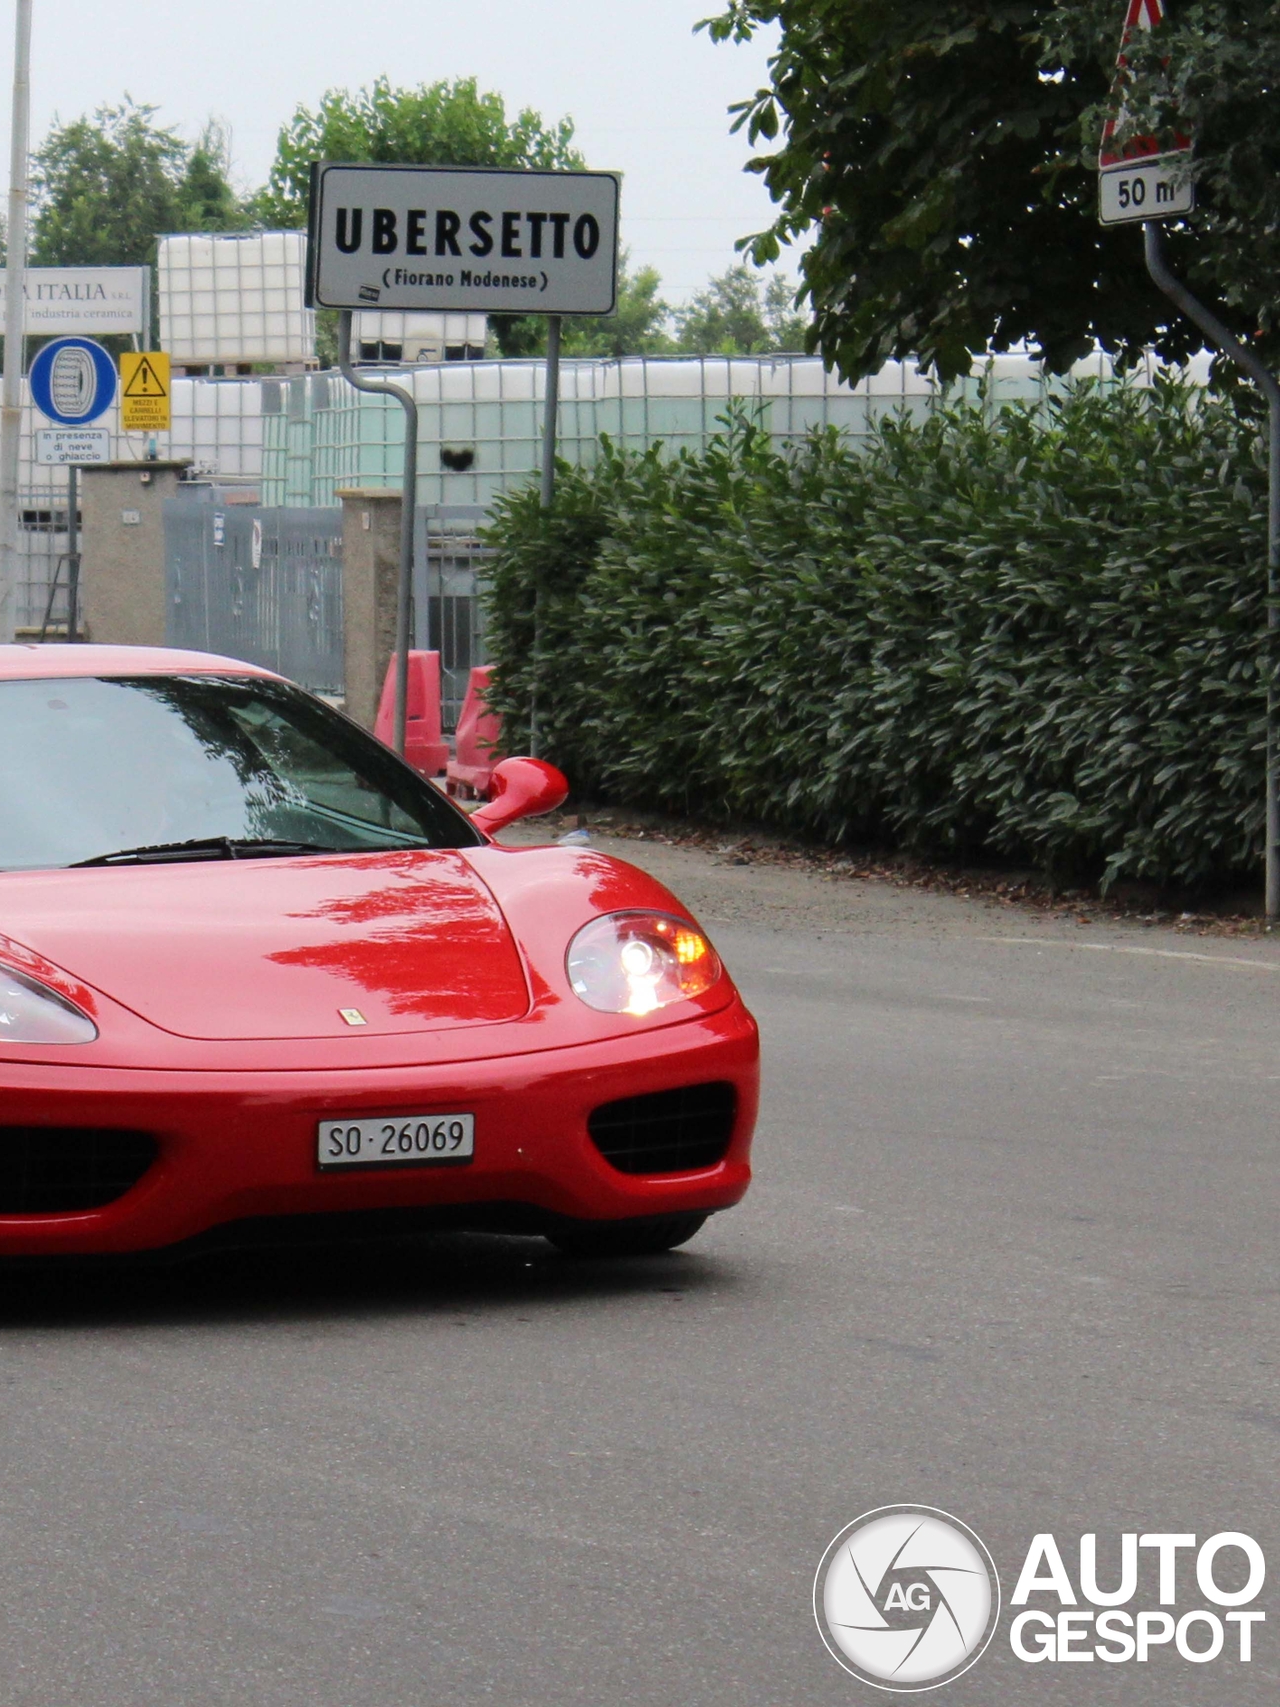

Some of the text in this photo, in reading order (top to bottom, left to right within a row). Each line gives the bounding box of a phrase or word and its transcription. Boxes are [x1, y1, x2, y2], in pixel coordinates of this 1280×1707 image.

[1118, 177, 1145, 208] 50
[334, 207, 601, 260] UBERSETTO
[36, 283, 107, 300] ITALIA
[83, 309, 133, 319] ceramica
[56, 432, 102, 442] presenza
[54, 443, 63, 451] di
[59, 452, 101, 462] ghiaccio
